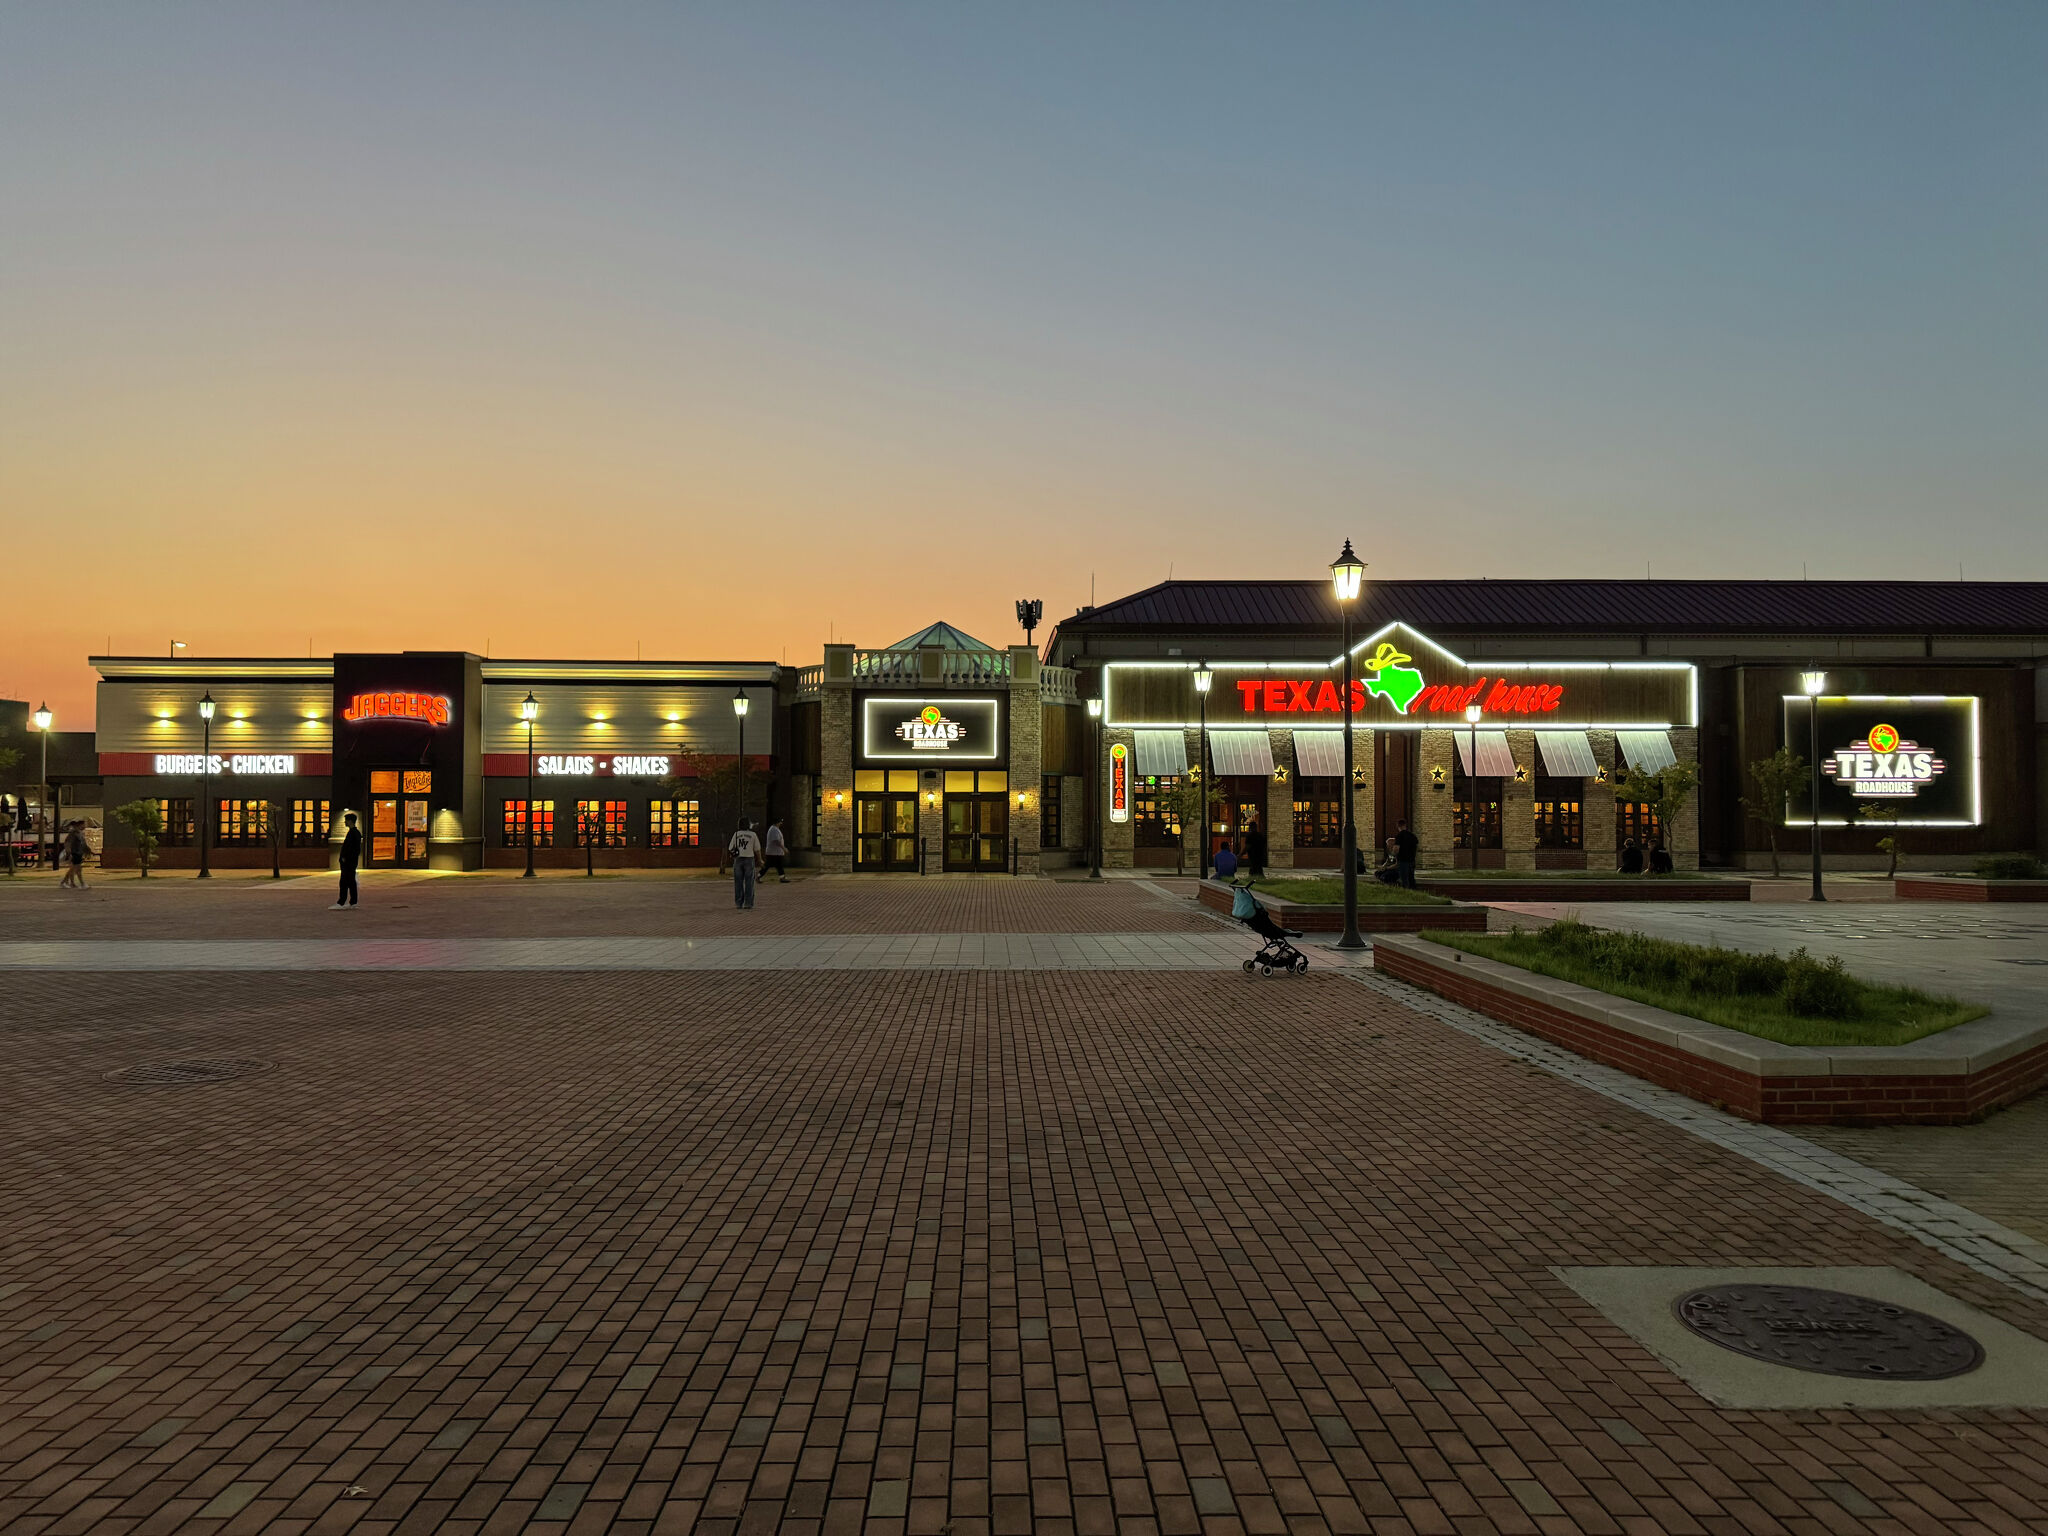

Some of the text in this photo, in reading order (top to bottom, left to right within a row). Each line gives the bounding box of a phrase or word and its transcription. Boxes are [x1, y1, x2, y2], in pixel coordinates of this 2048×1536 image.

[1237, 676, 1564, 713] TEXAS road house
[343, 692, 448, 727] JAGGERS
[901, 724, 959, 739] TEXAS
[156, 755, 294, 774] BURGERS CHICKEN
[538, 756, 669, 775] SALADS SHAKES
[1836, 753, 1932, 778] TEXAS
[1115, 758, 1124, 809] TEXAS
[1855, 781, 1914, 793] ROADHOUSE
[1764, 1319, 1881, 1332] SEWER
